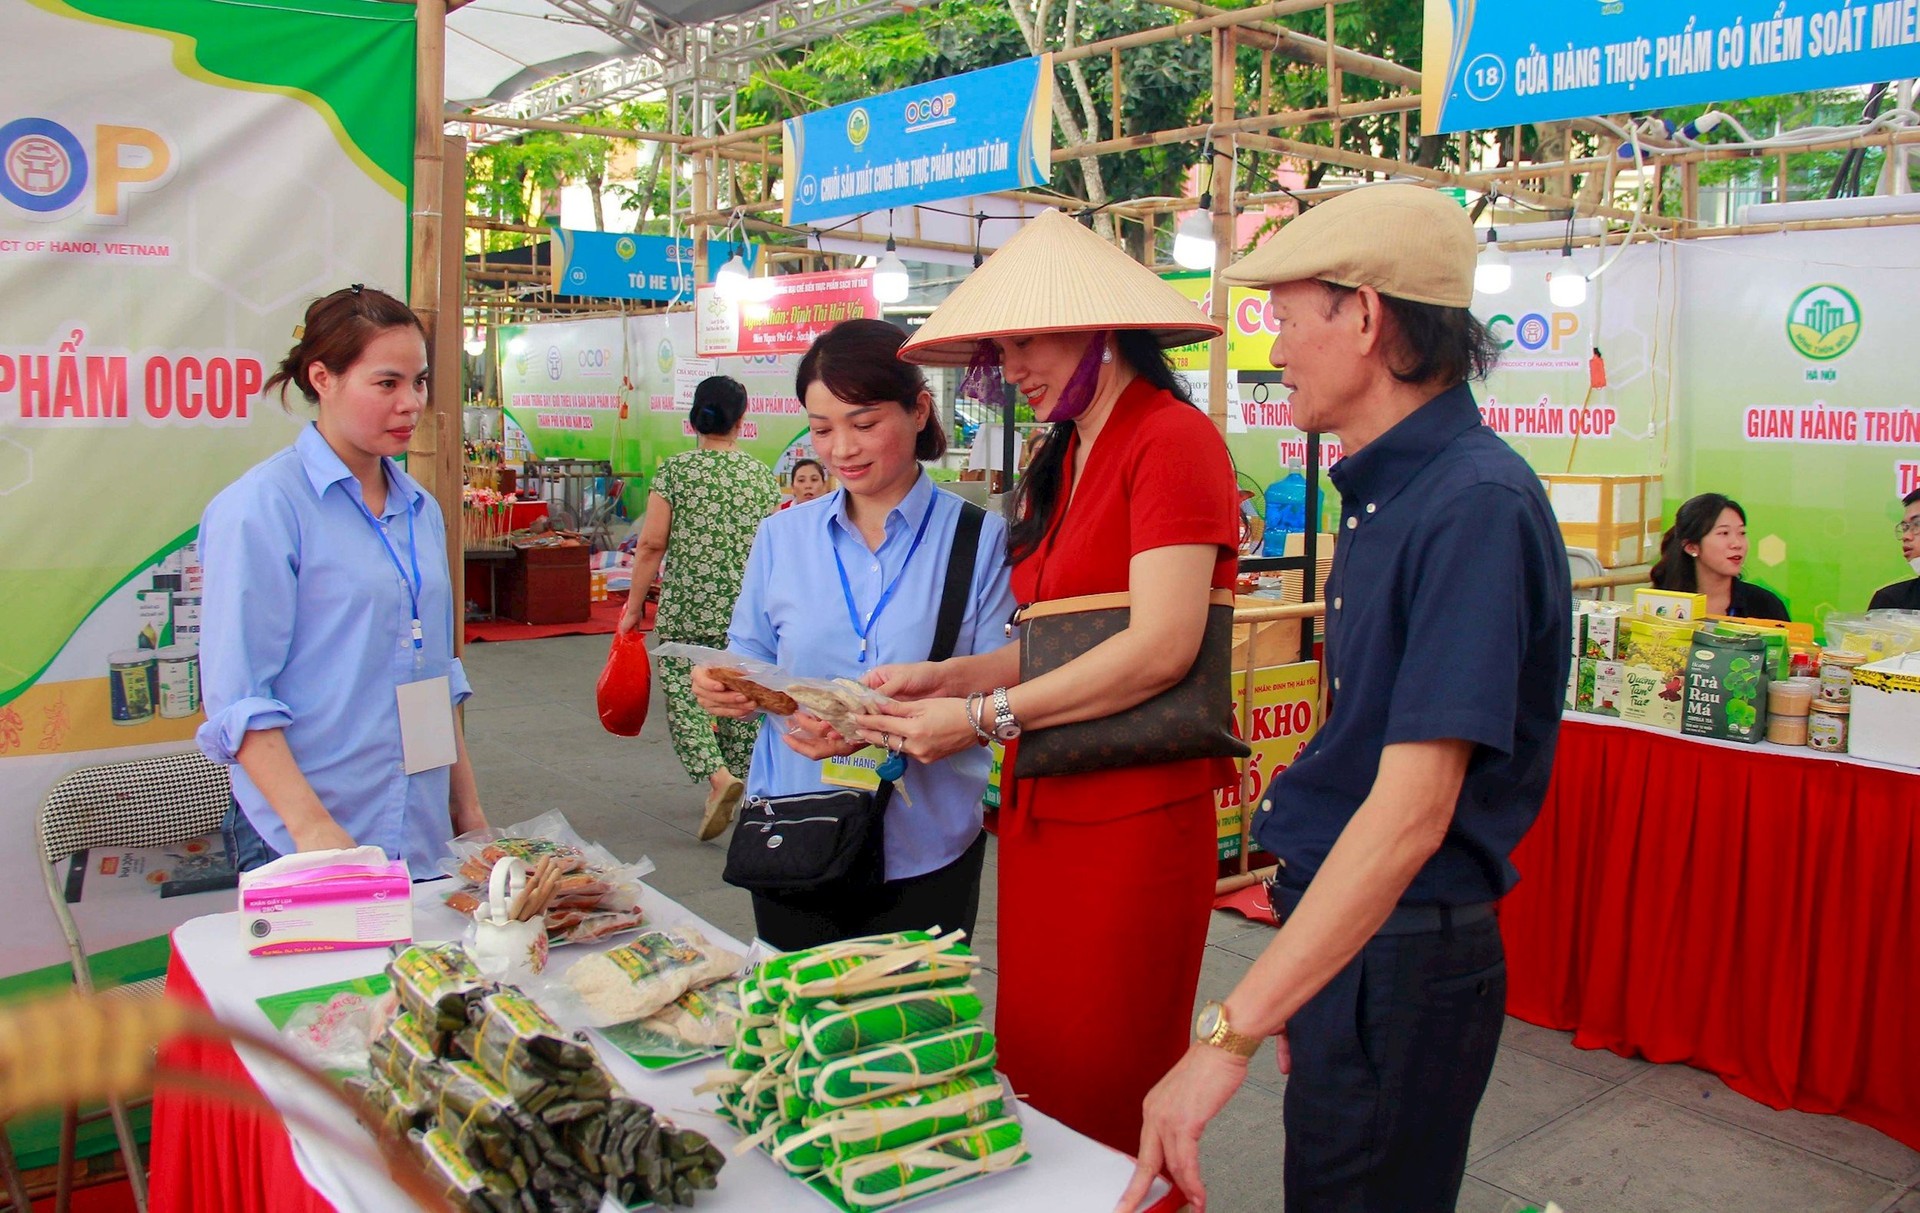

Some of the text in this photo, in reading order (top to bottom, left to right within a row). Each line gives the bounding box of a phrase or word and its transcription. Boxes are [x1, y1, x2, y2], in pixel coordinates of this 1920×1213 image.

[1475, 66, 1499, 88] 18
[1515, 43, 1549, 97] CỬA
[1552, 41, 1600, 92] HÀNG
[1605, 35, 1650, 91] THỰC
[1655, 14, 1713, 78] PHẨM
[1716, 16, 1744, 71] CÓ
[1749, 0, 1804, 67] KIỂM
[1808, 0, 1868, 59] SOÁT
[905, 92, 955, 124] OCOP
[803, 183, 814, 197] 01
[874, 165, 893, 192] CUNG
[911, 155, 930, 191] THỰC
[930, 142, 953, 182] PHẨM
[955, 148, 976, 184] SẠCH
[25, 241, 45, 252] OF
[50, 241, 100, 256] HANOI,
[104, 243, 169, 257] VIETNAM
[572, 270, 584, 281] 03
[628, 270, 646, 288] TÒ
[649, 273, 667, 289] HE
[1487, 311, 1579, 351] COP
[578, 348, 611, 368] OCOP
[143, 356, 263, 420] OCOP
[1240, 400, 1294, 427] NG TRƯN
[1477, 397, 1616, 435] SẢN PHẨM OCOP
[1747, 408, 1794, 439] GIAN
[1800, 404, 1858, 441] HÀNG
[1688, 686, 1721, 704] Rau
[1690, 673, 1719, 690] Trà
[1250, 700, 1312, 742] KHO
[1687, 701, 1712, 717] Má
[831, 755, 876, 770] GIAN HÀNG
